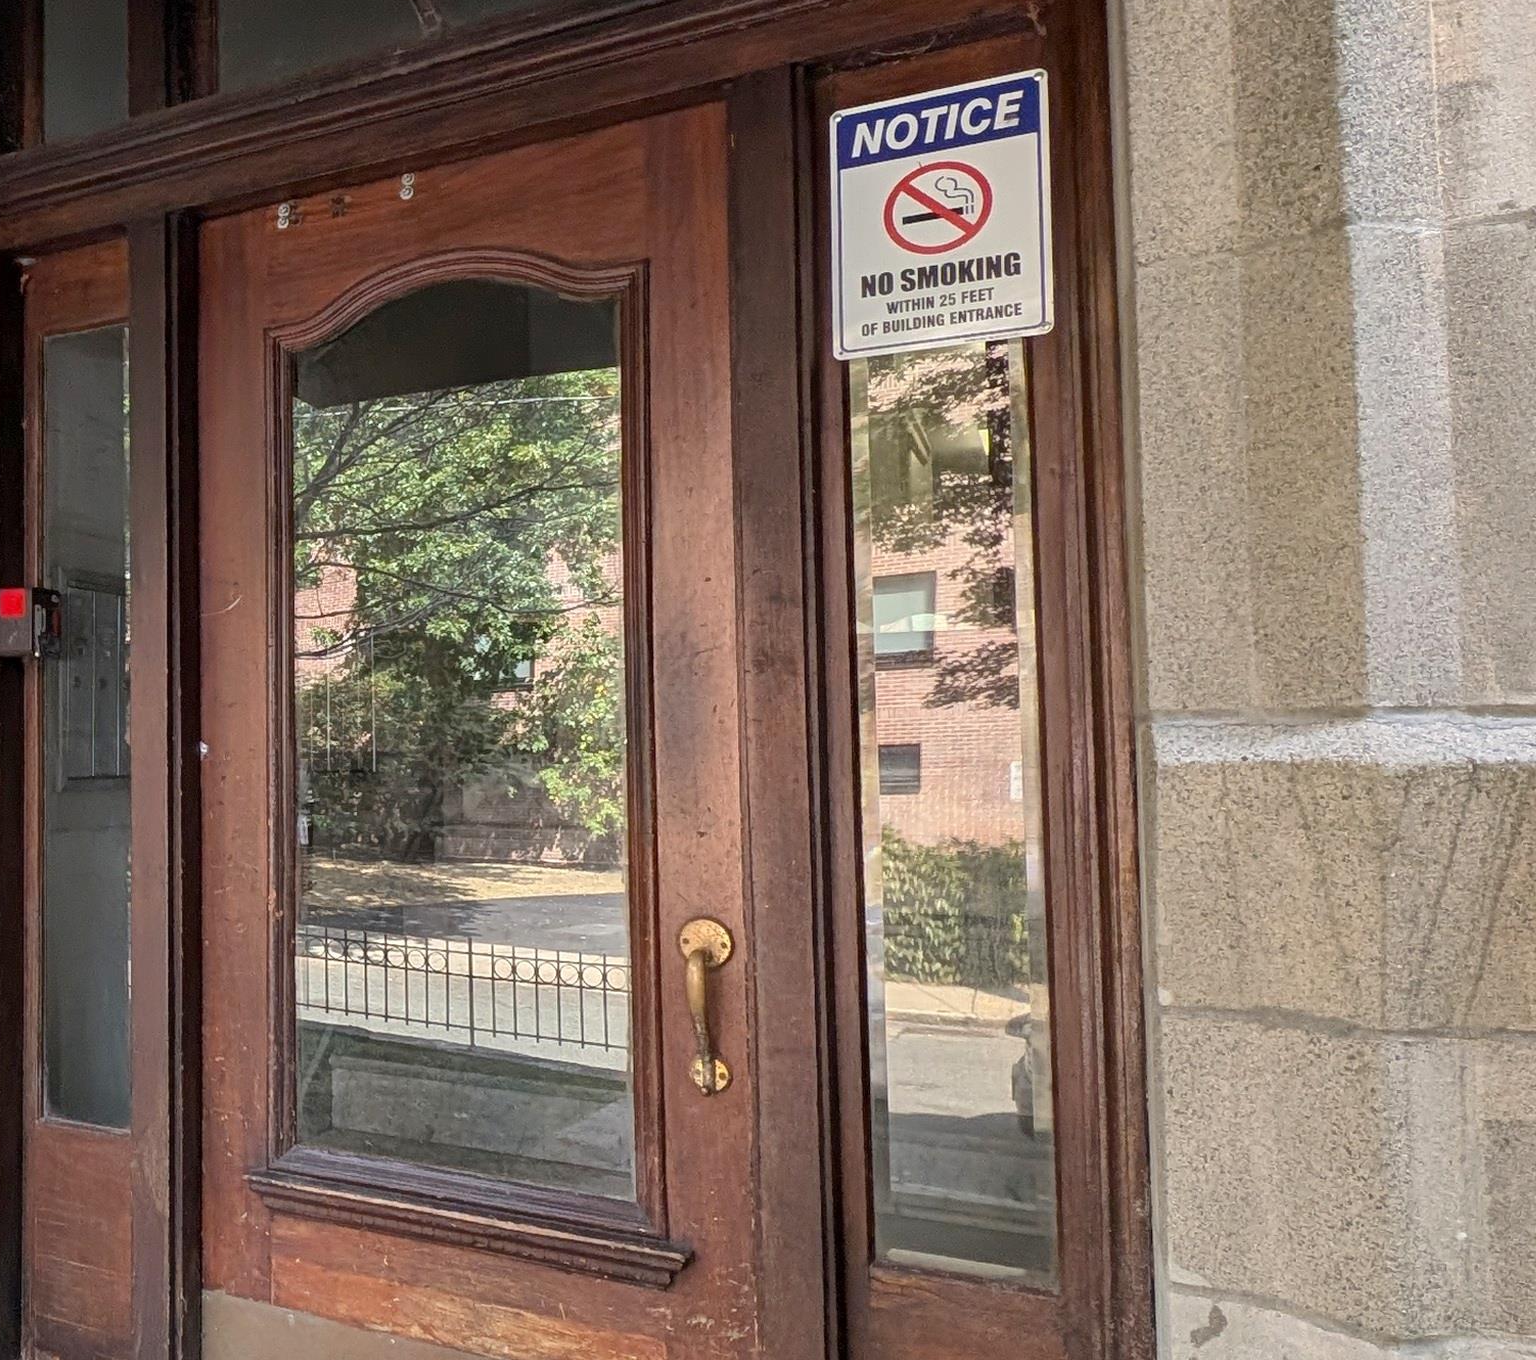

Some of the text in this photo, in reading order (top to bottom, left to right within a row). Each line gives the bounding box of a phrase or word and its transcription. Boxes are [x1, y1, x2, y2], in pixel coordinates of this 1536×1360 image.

[851, 90, 1024, 158] NOTICE
[861, 252, 1021, 298] NO SMOKING
[861, 302, 1023, 337] OF BUILDING ENTRANCE
[886, 287, 994, 315] WITHIN 25 FEET
